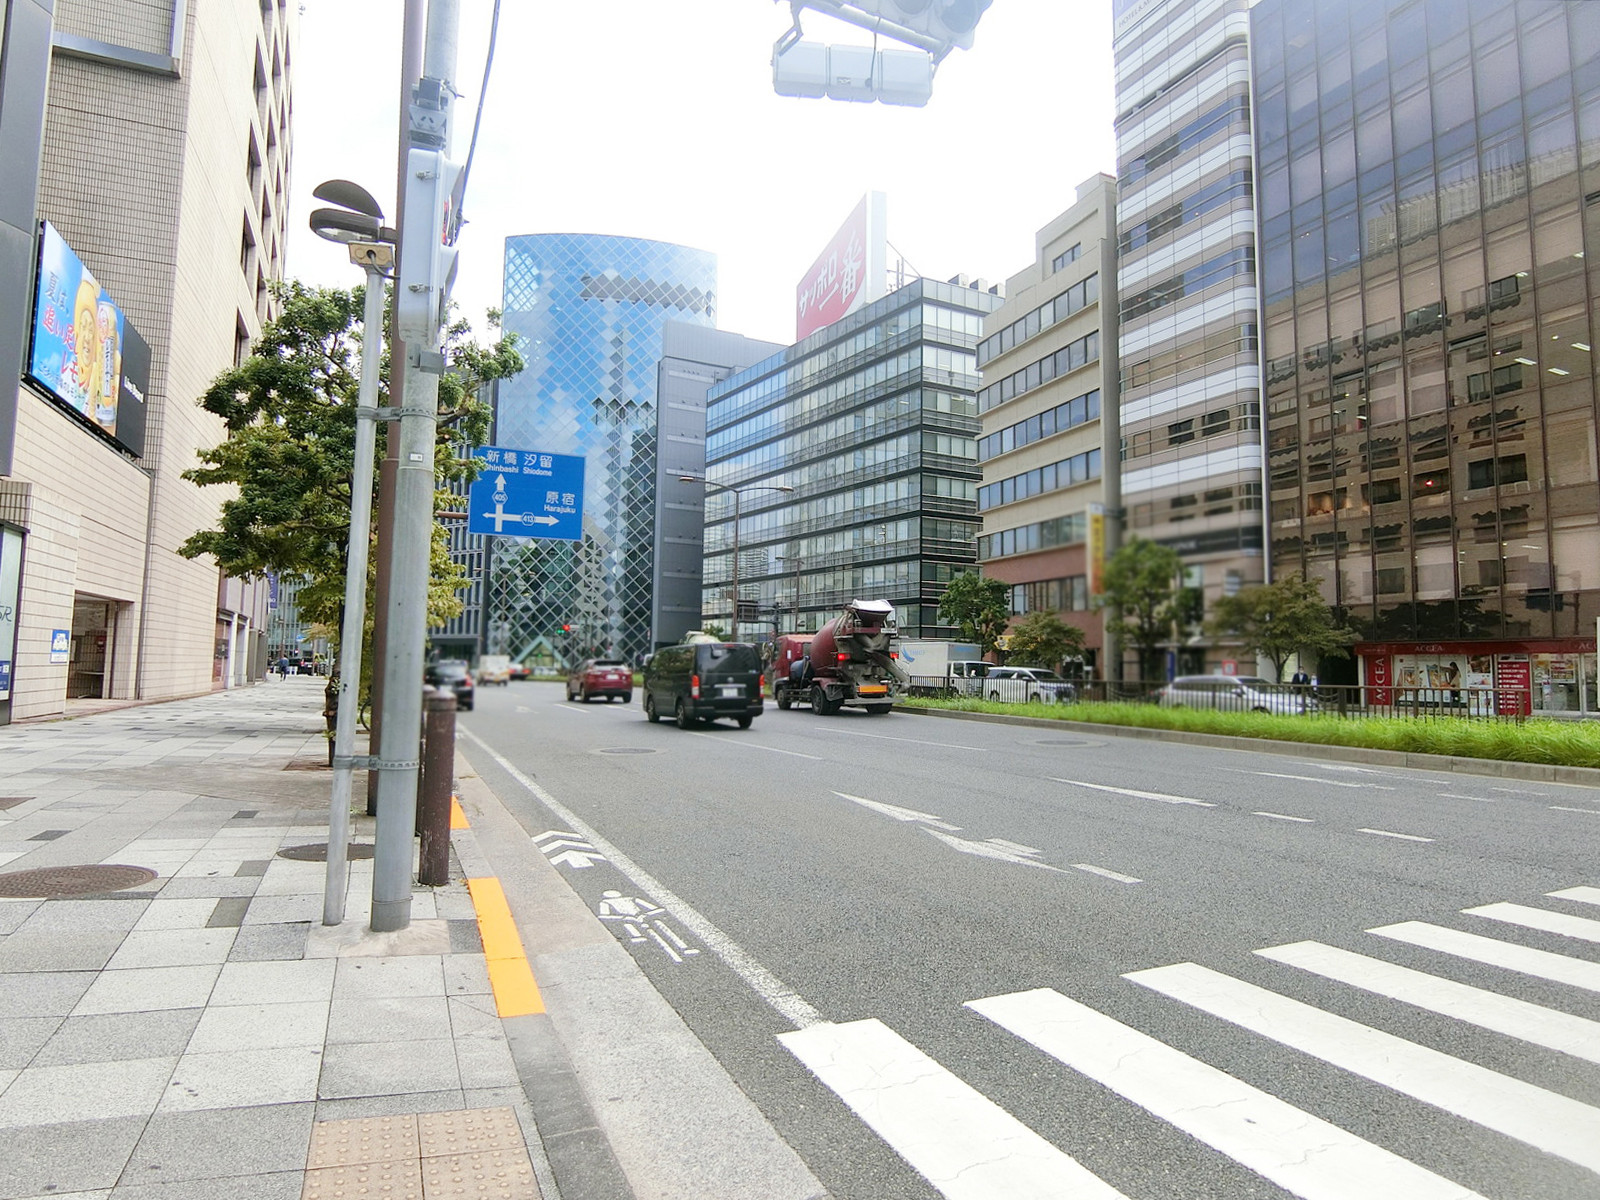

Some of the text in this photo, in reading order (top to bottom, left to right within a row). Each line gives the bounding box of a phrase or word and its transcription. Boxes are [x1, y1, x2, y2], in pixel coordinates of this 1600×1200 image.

[819, 230, 862, 311] 一番
[798, 250, 837, 318] サッポロ
[486, 449, 553, 468] 新橋 汐留
[523, 467, 552, 477] Shiodome
[545, 490, 576, 506] 原宿
[543, 504, 576, 514] Harajuku
[522, 514, 534, 523] 413
[1414, 644, 1443, 652] ACCEA
